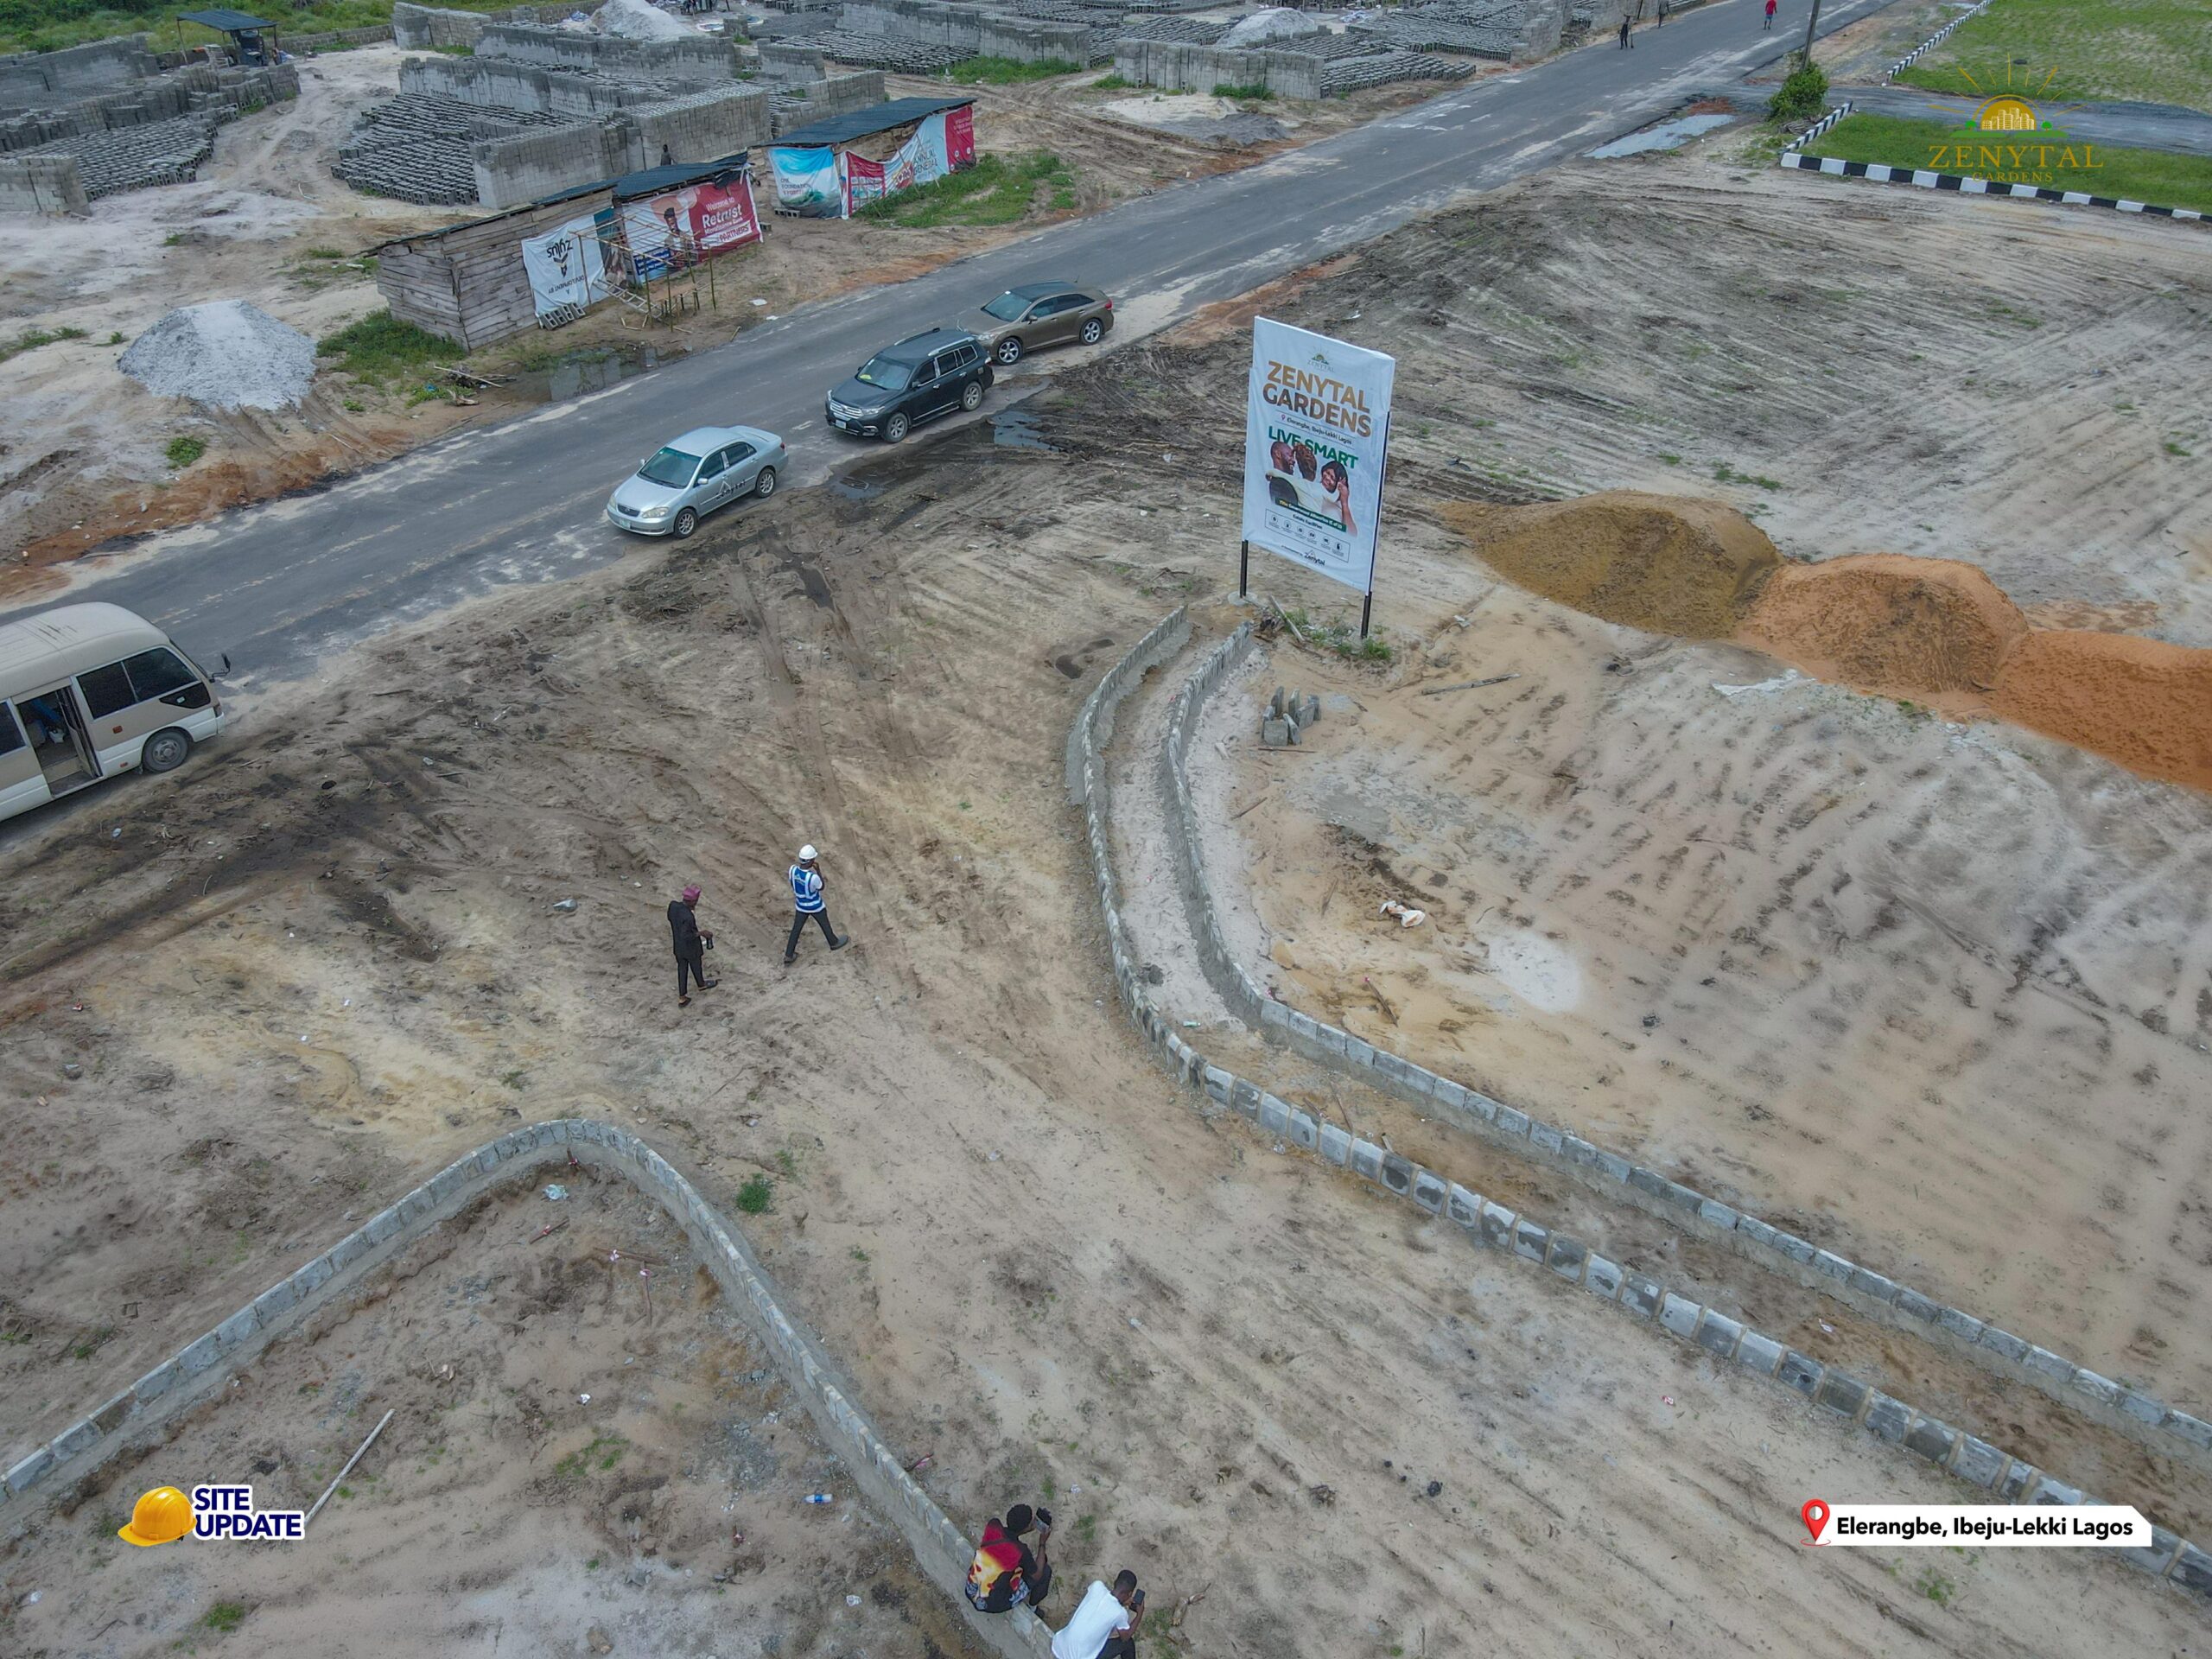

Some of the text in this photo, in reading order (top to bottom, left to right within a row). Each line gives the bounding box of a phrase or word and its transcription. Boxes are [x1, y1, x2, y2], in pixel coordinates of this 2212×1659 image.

[702, 204, 742, 228] Retrust
[1262, 383, 1372, 438] GARDENS
[1267, 360, 1370, 414] ZENYTAL
[1268, 425, 1359, 470] LIVE SMART
